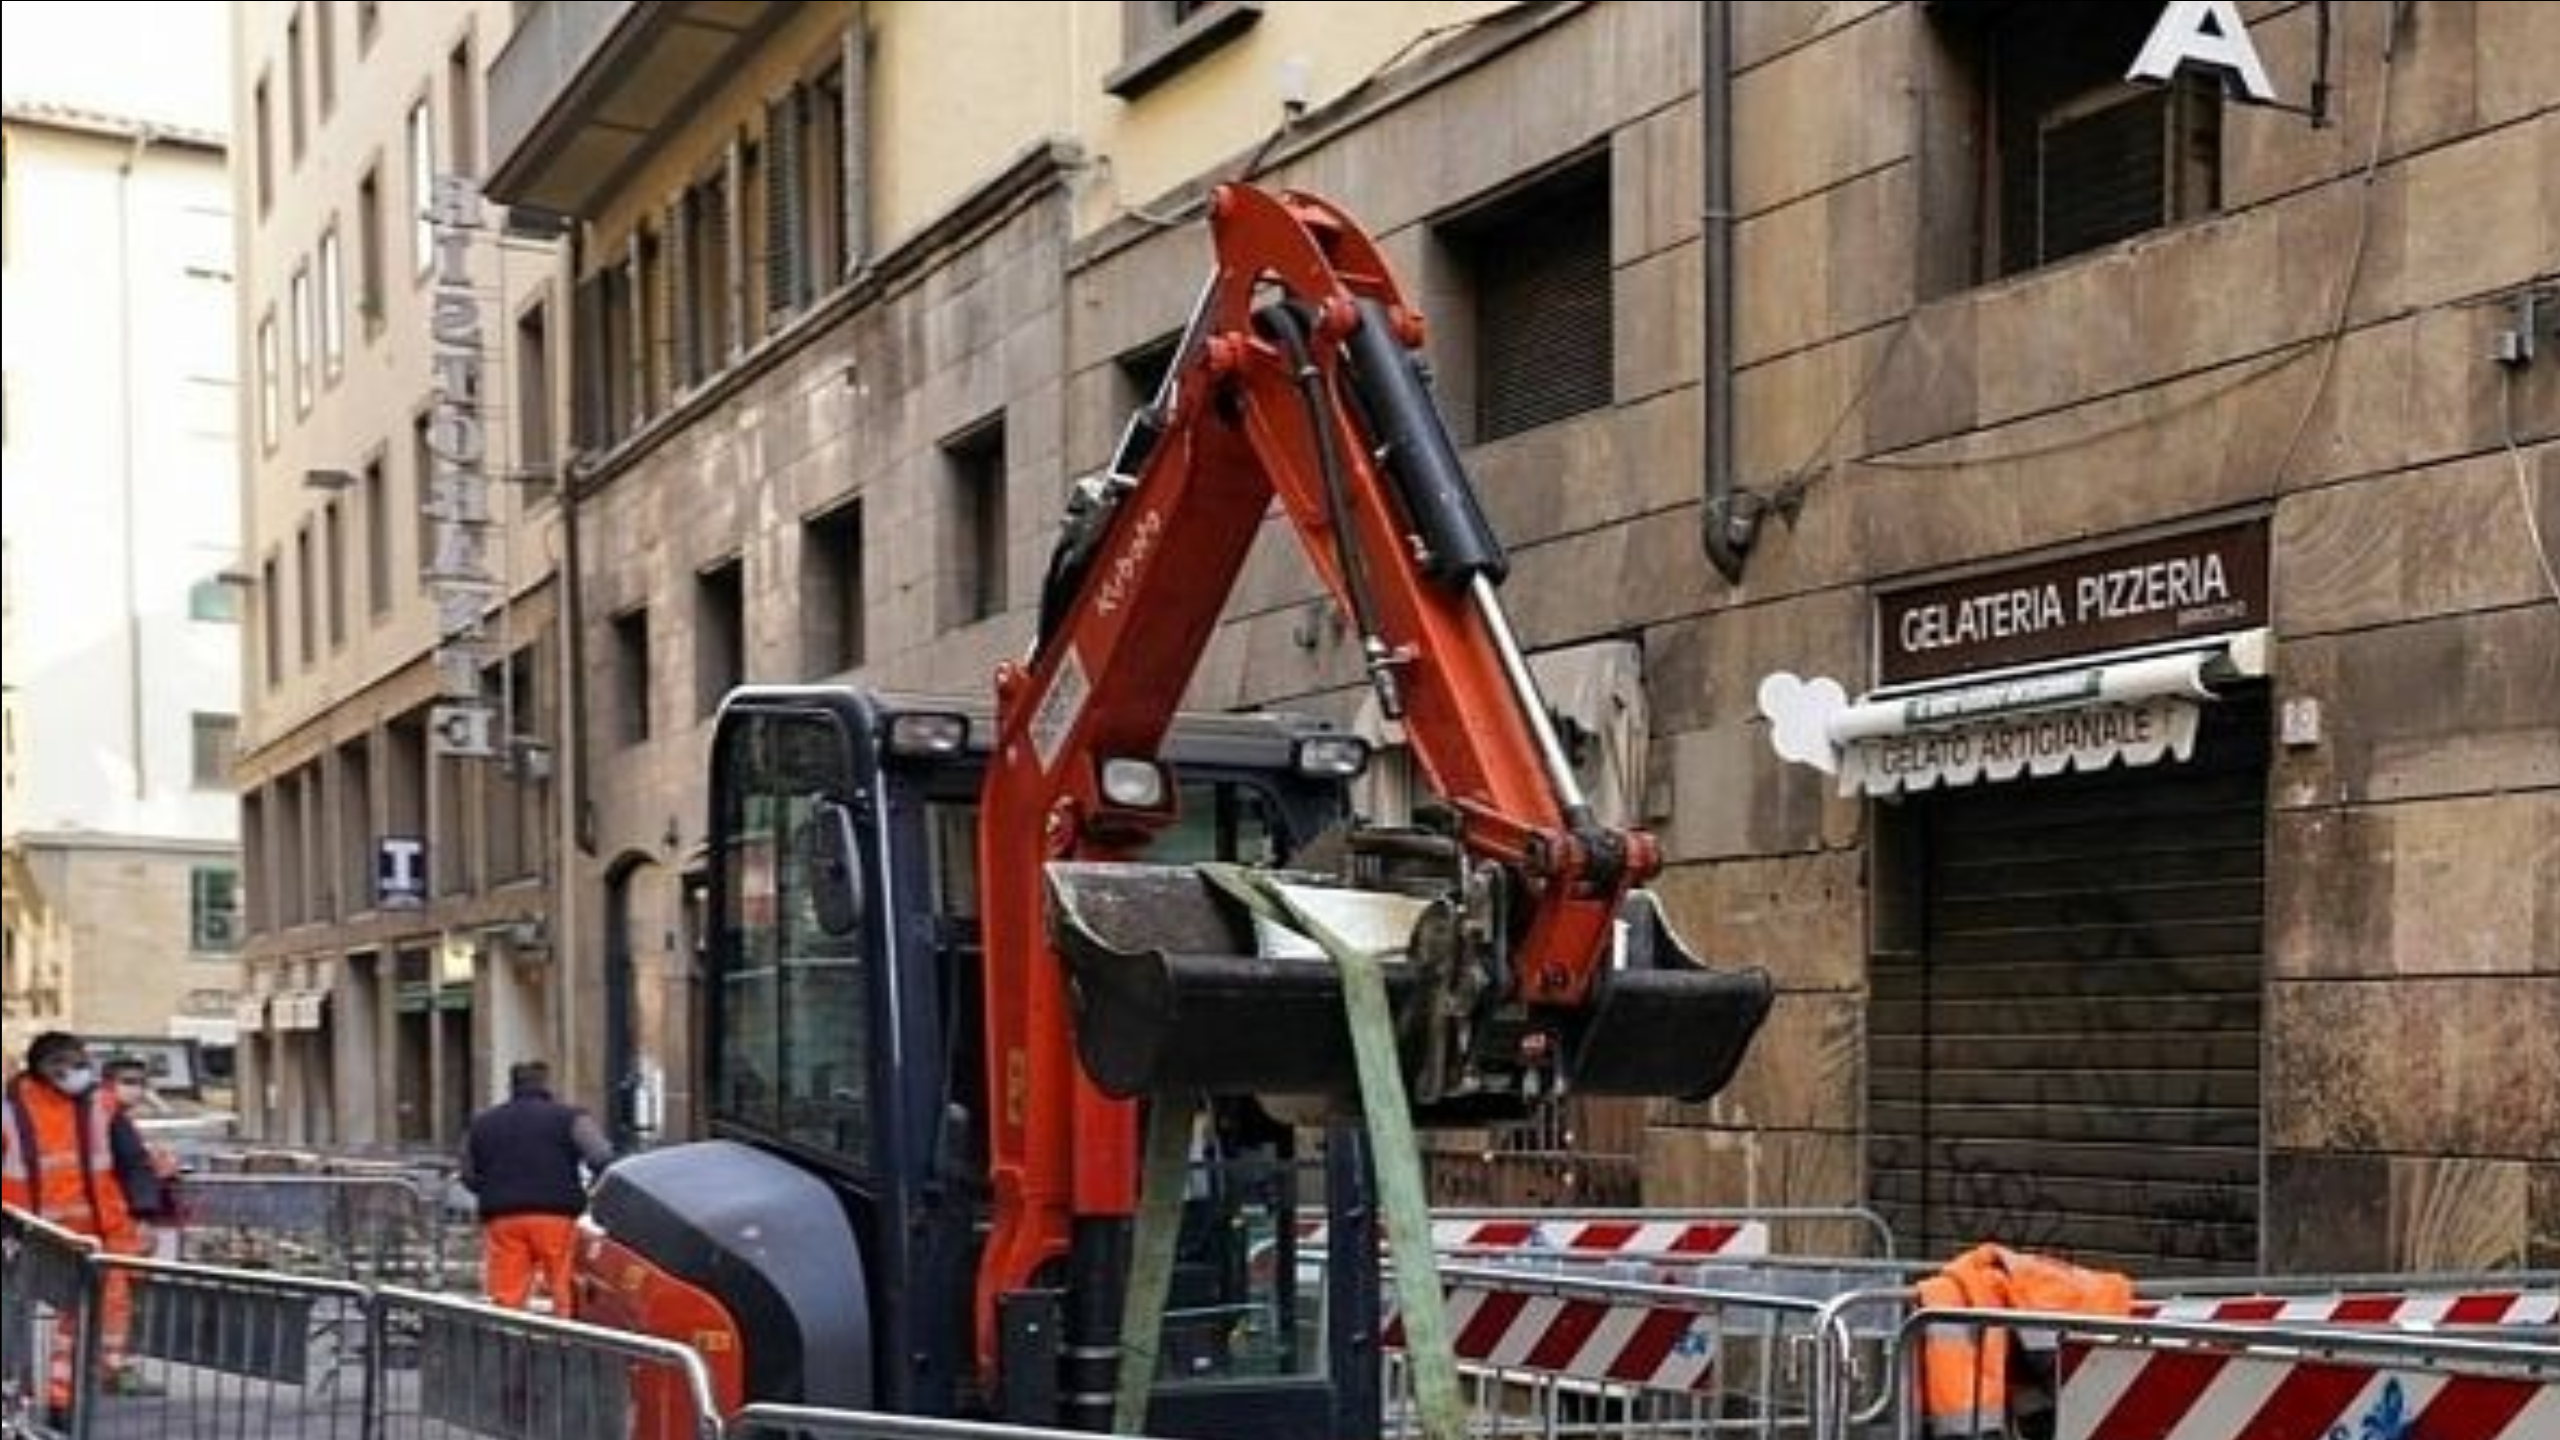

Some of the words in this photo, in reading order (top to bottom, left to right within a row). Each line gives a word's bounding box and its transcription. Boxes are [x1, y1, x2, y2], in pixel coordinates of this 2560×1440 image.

[2124, 0, 2278, 101] A
[1900, 583, 2066, 652] GELATERIA
[2076, 552, 2230, 623] PIZZERIA
[1882, 732, 1971, 774] GELATO
[1982, 706, 2152, 762] ARTIGIANALE
